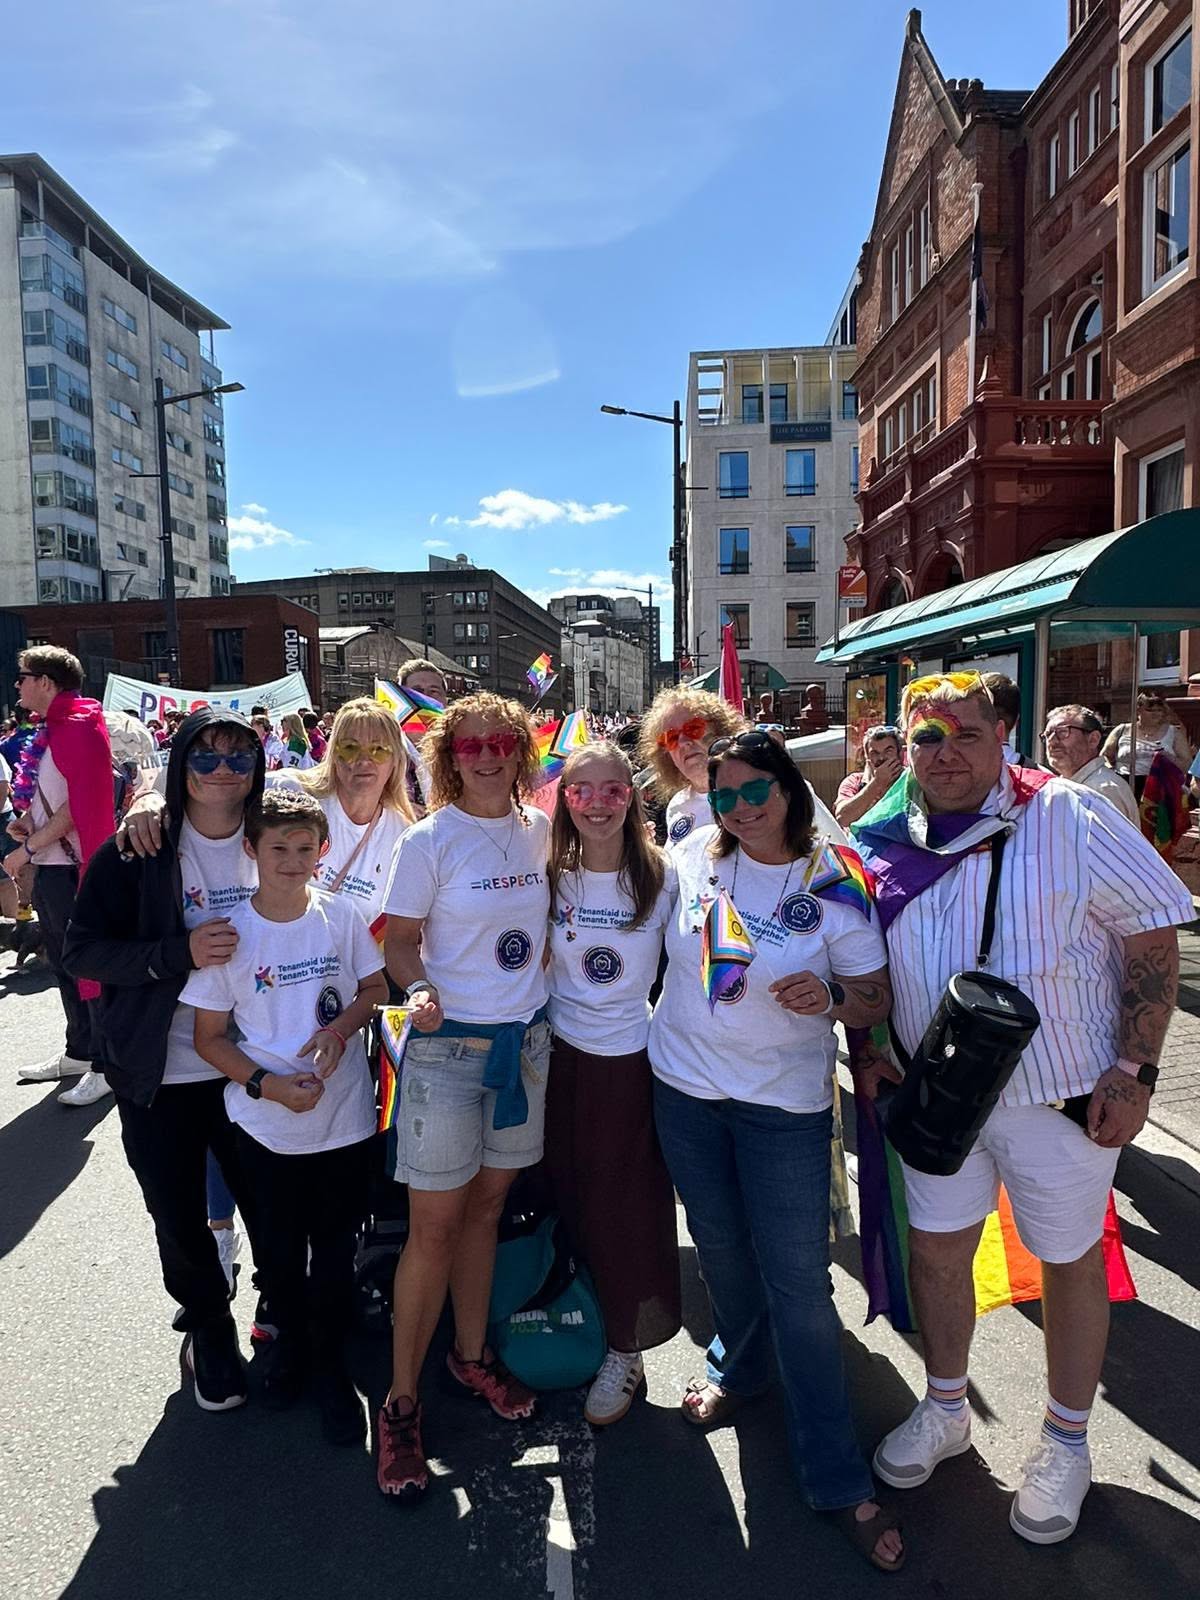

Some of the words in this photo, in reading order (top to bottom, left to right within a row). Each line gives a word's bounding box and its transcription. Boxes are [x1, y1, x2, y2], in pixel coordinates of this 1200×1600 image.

[579, 907, 619, 917] Tenantiaid
[578, 915, 607, 924] Tenants
[278, 957, 318, 972] Tenantiaid
[278, 970, 308, 981] Tenants
